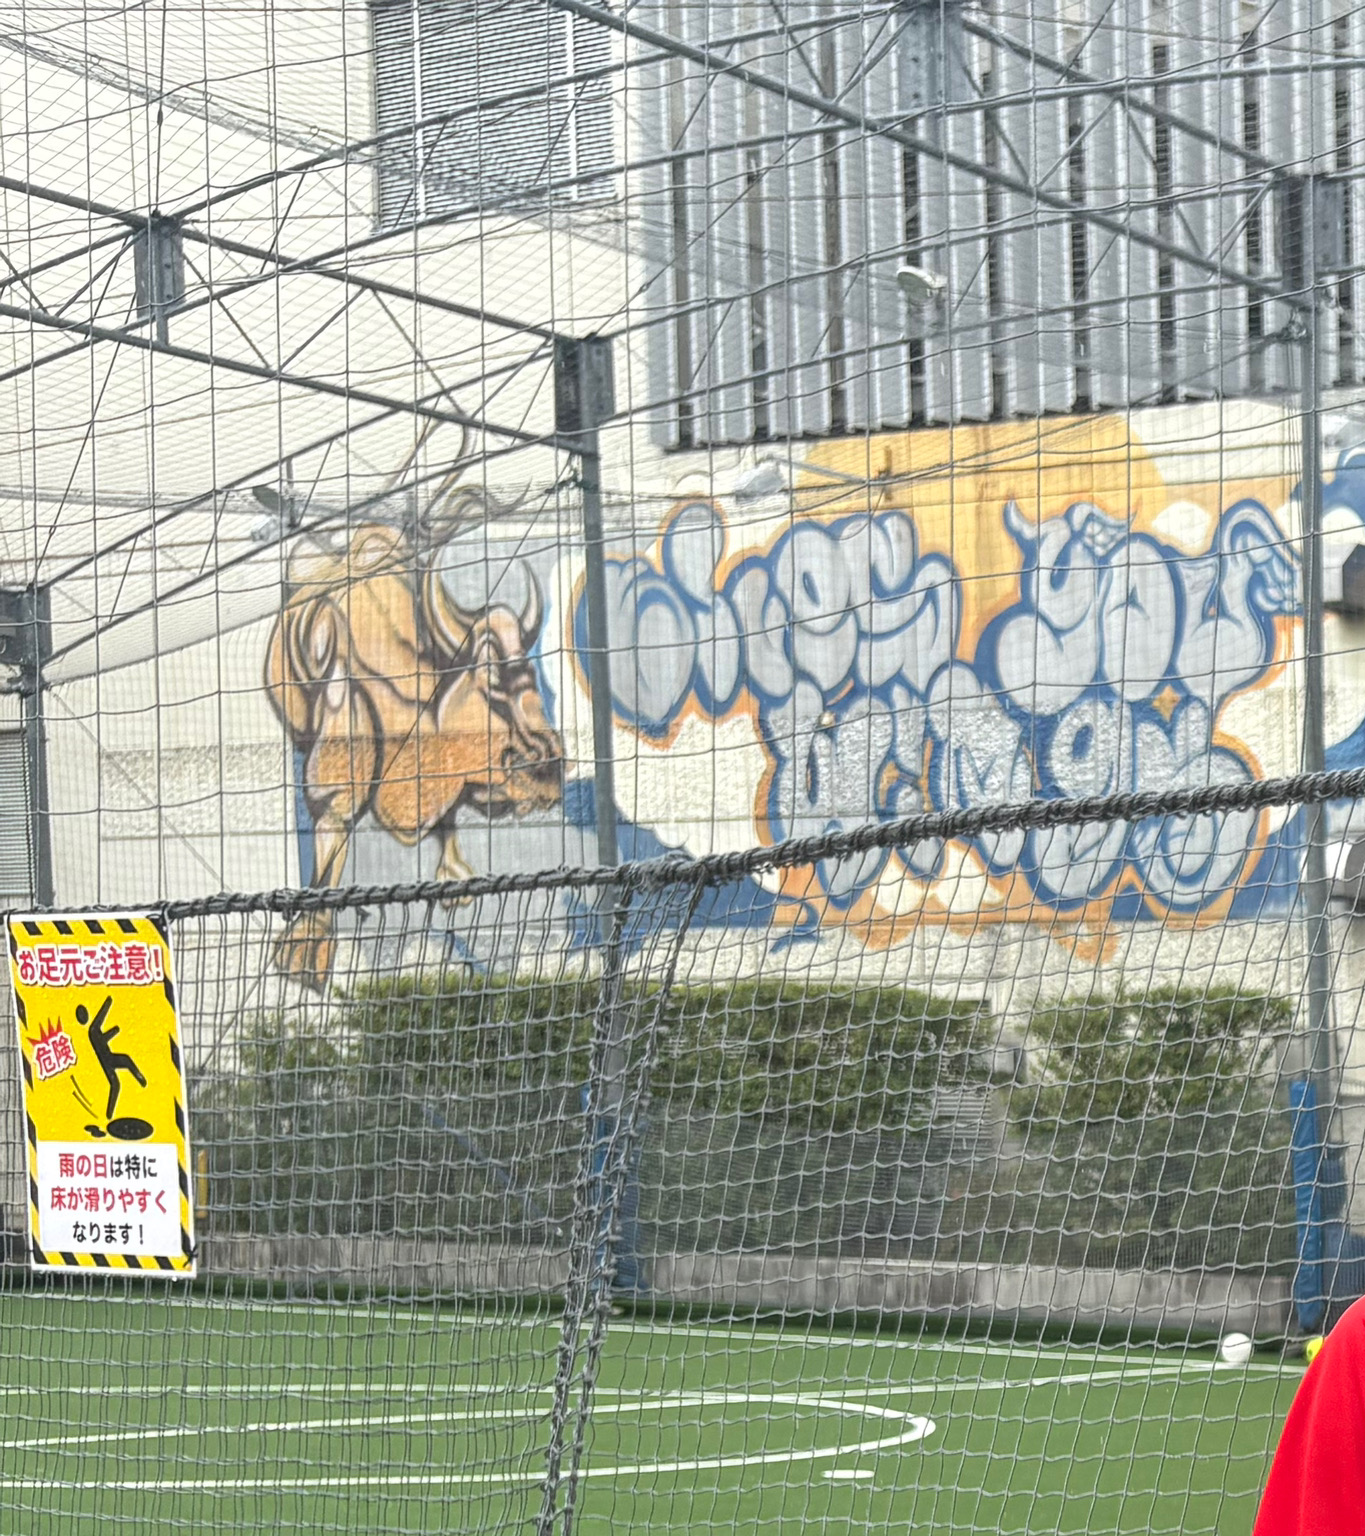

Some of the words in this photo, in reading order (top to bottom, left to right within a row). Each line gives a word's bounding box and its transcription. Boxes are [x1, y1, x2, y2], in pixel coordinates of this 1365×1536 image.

[18, 943, 163, 983] お足元ご注意！
[35, 1035, 74, 1076] 危険
[58, 1152, 158, 1180] 雨の日は特に
[50, 1186, 167, 1214] 床が滑りやすく
[72, 1221, 144, 1245] なります！
